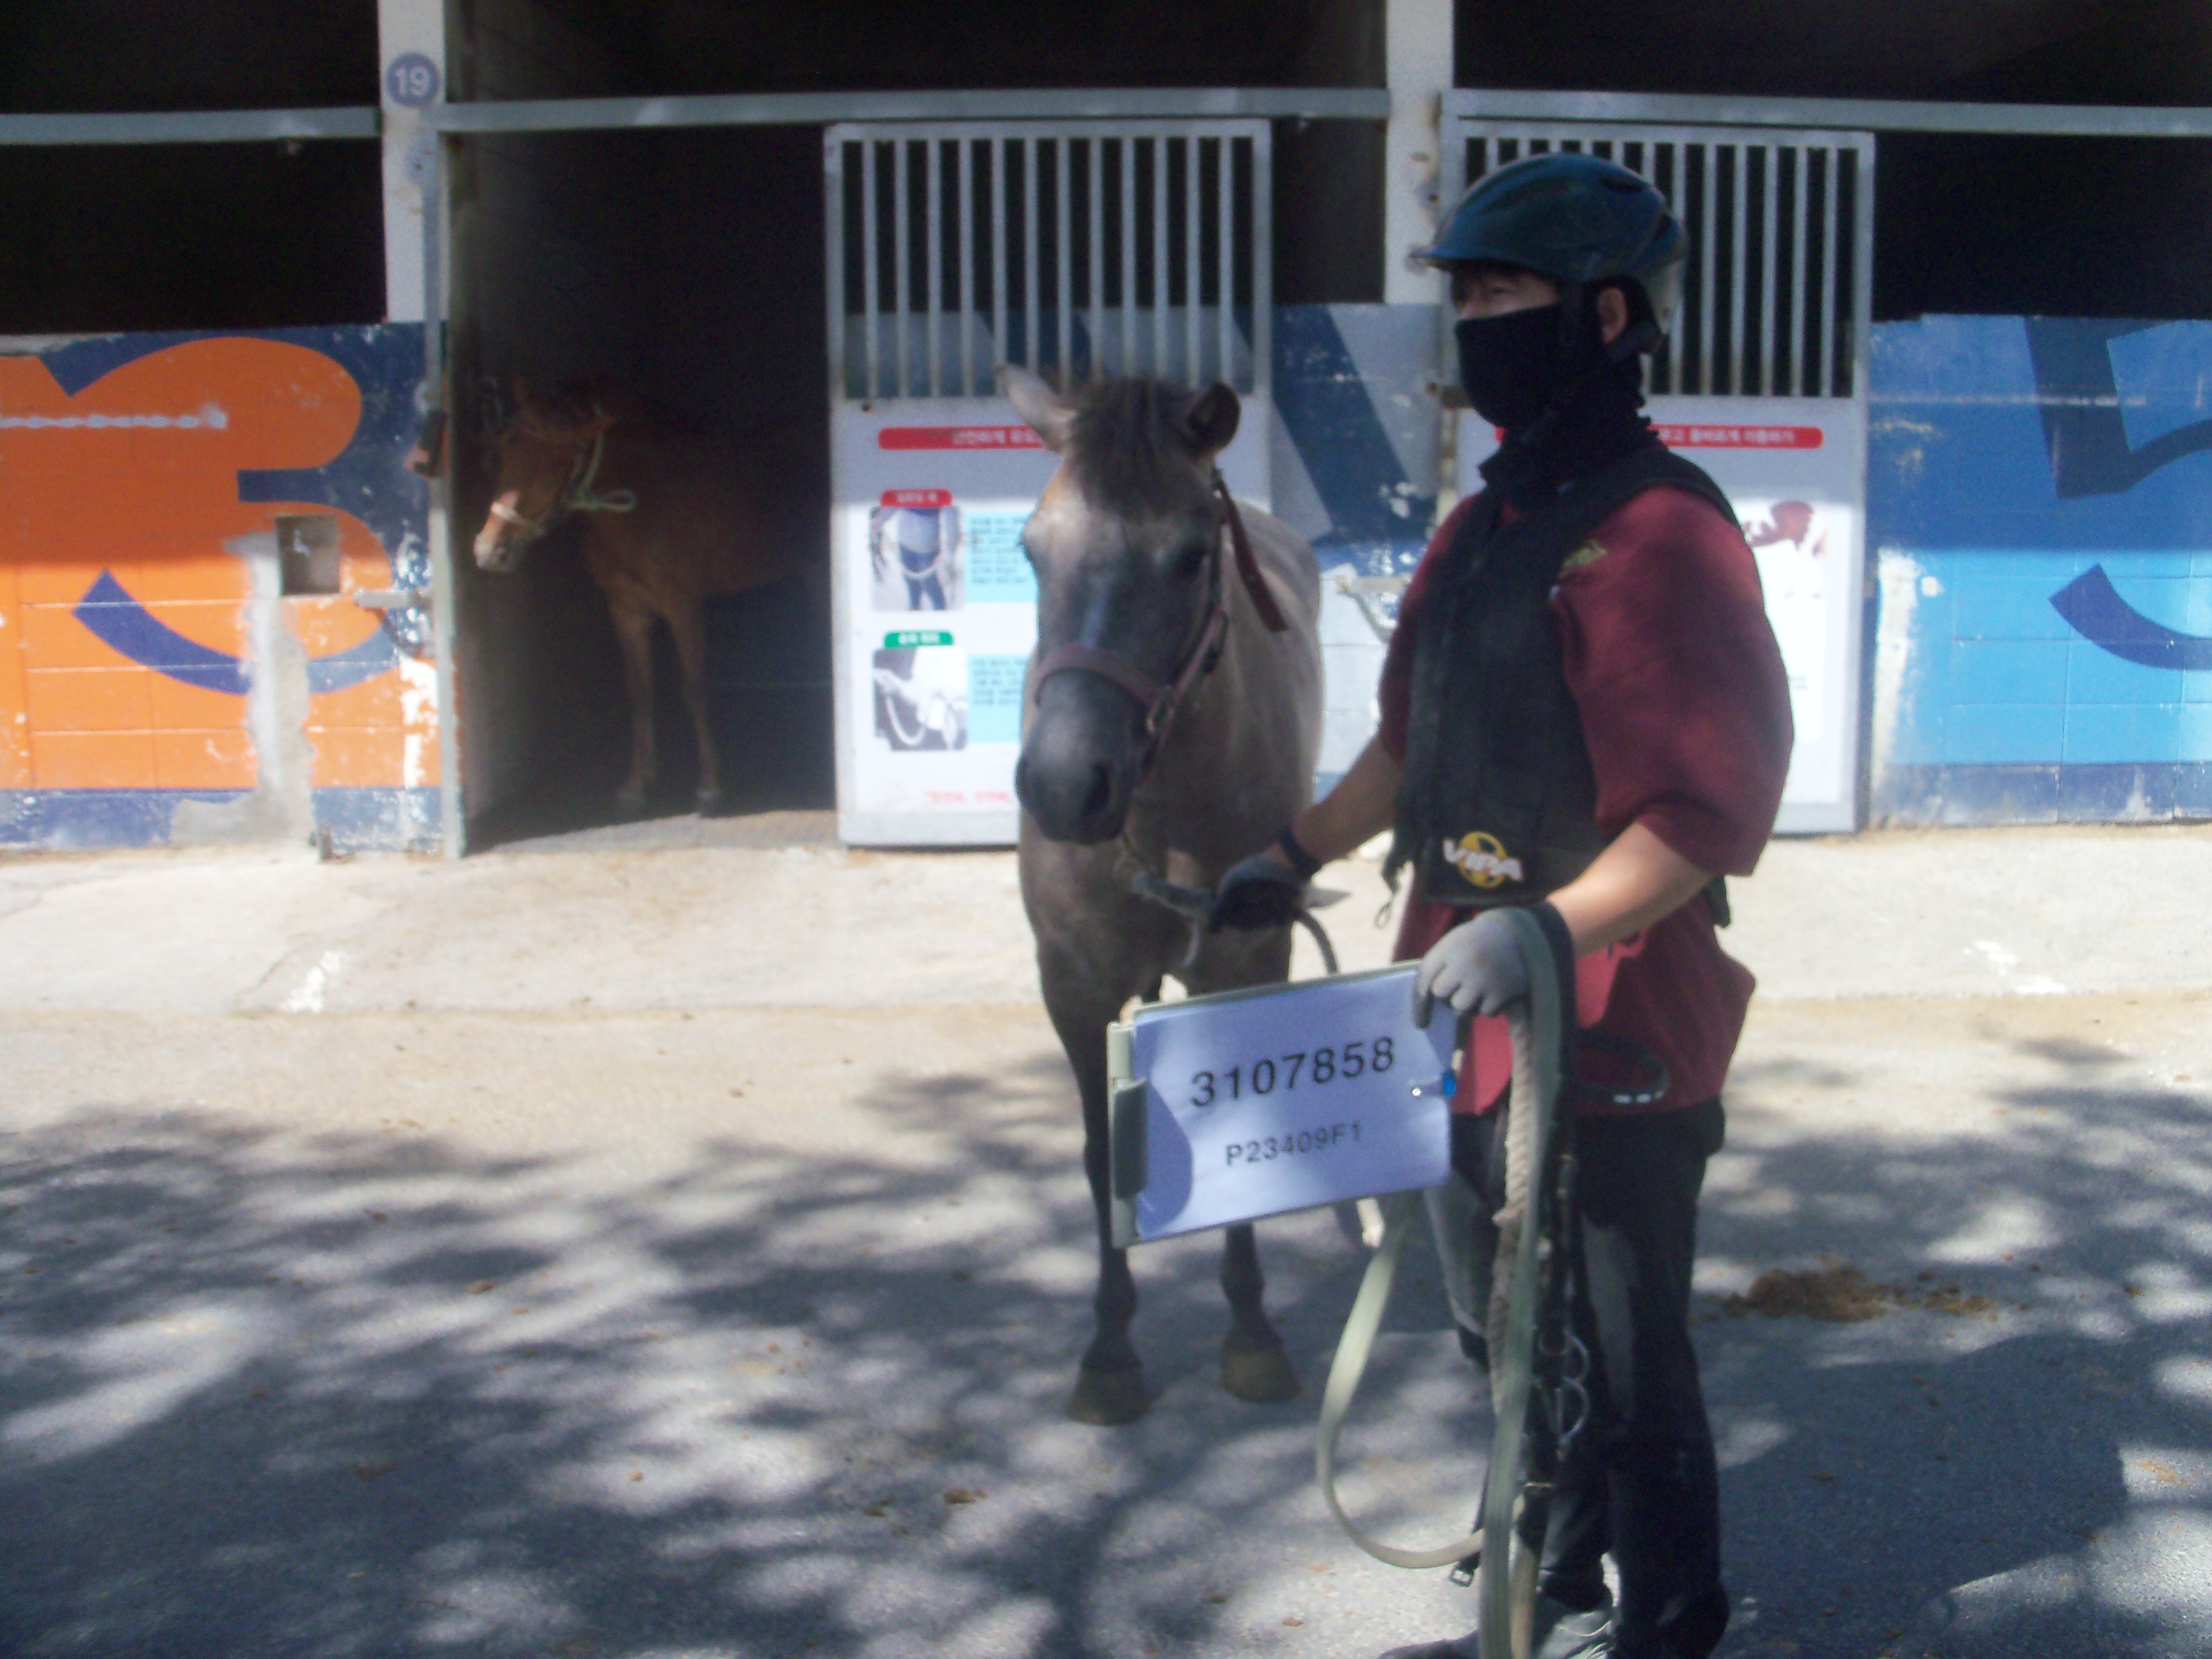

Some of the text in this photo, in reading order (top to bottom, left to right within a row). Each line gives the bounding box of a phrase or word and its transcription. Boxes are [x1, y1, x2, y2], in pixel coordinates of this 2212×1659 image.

[394, 64, 430, 97] 19
[1191, 1036, 1394, 1107] 3107858
[1225, 1122, 1361, 1166] P23409F1
